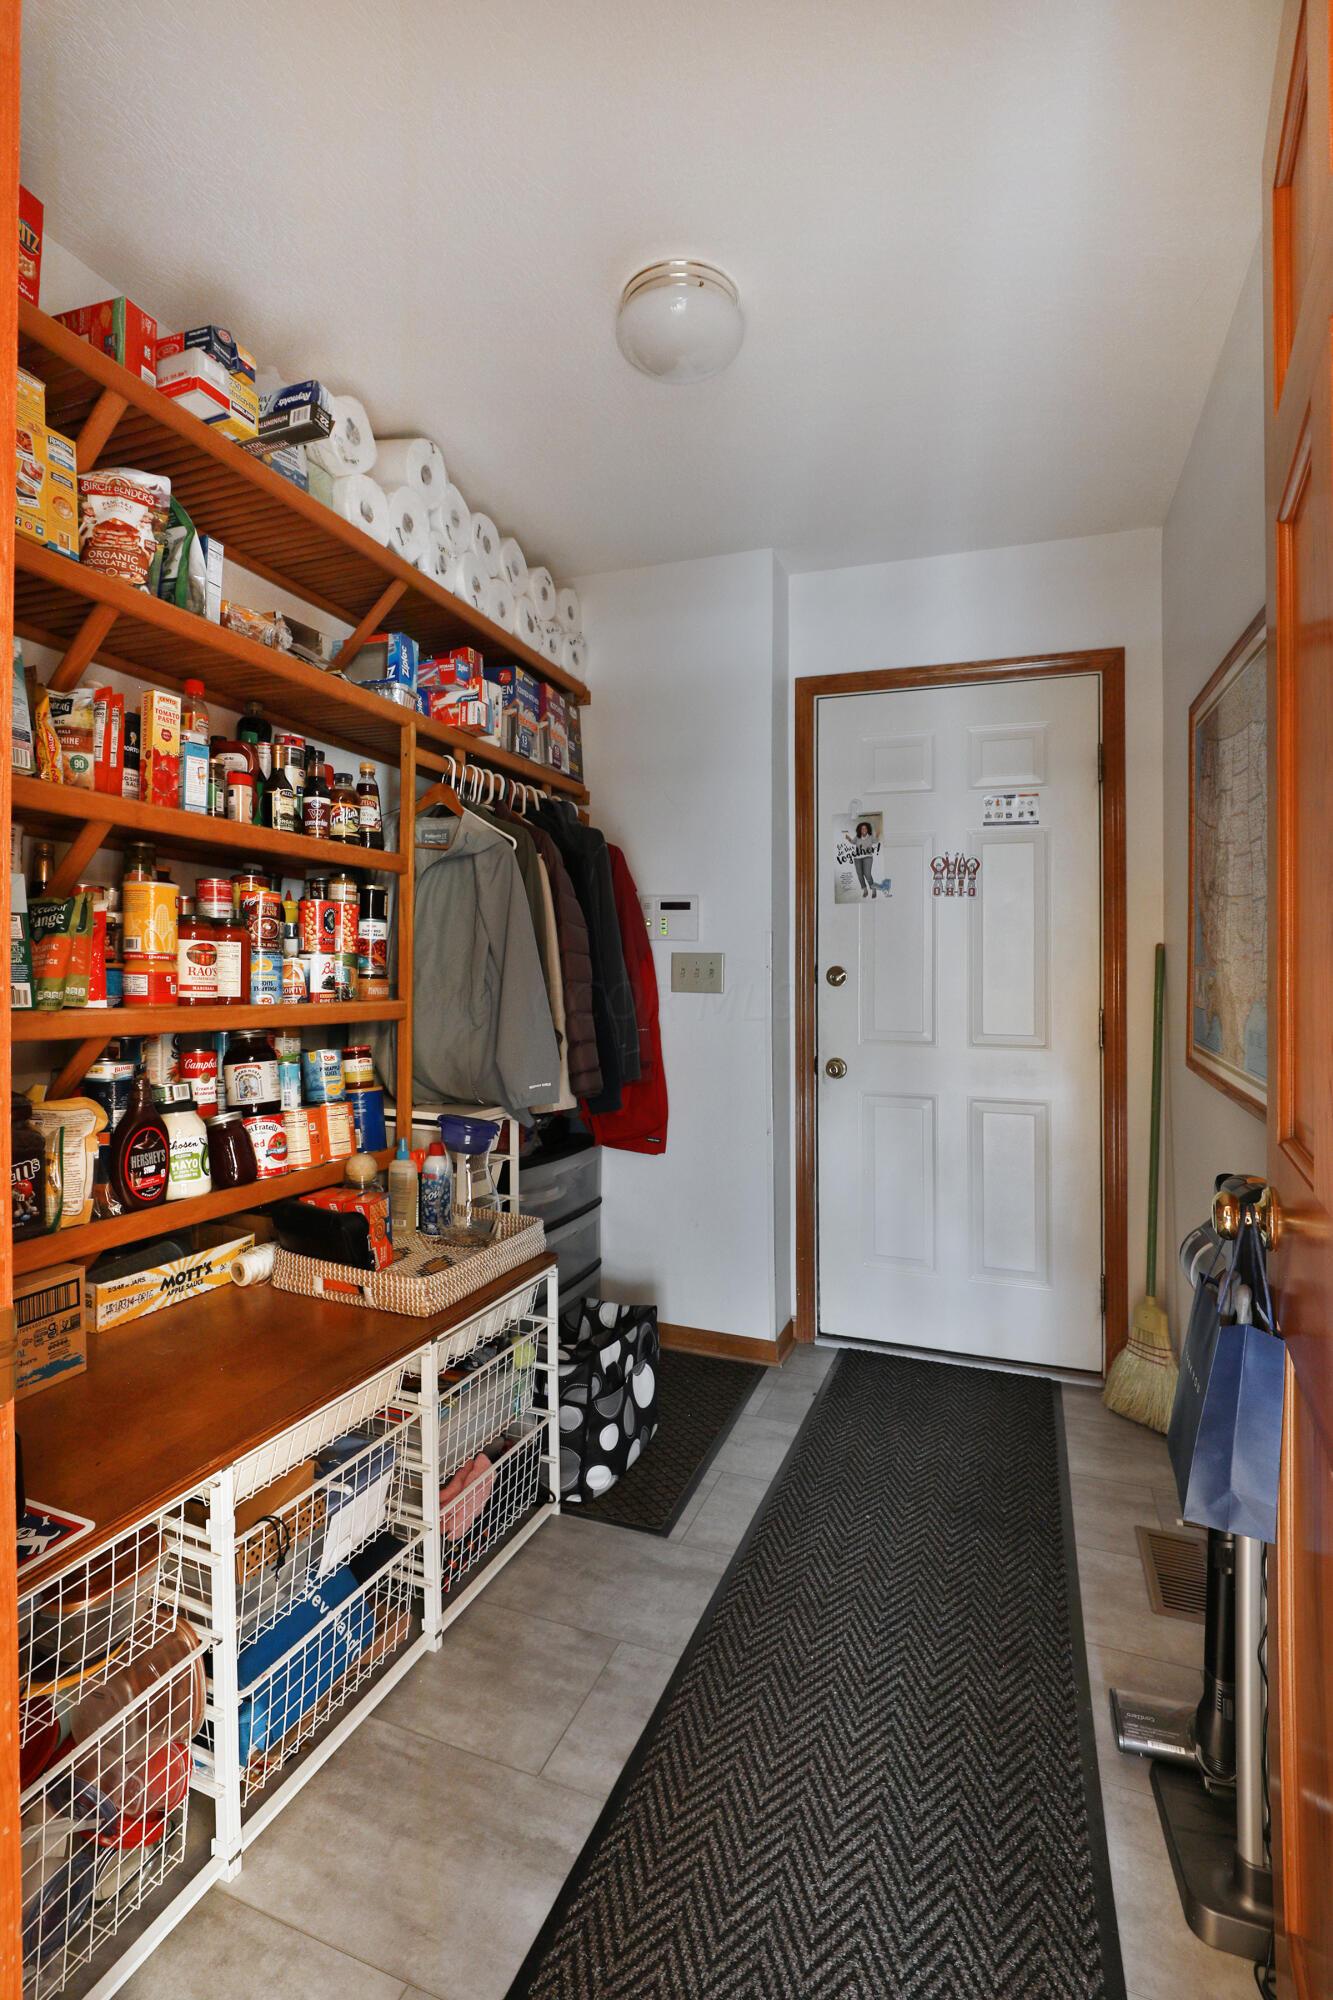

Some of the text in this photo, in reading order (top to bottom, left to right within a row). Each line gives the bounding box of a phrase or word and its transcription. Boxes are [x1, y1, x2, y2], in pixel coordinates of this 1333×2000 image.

[81, 480, 113, 492] BIRCH
[113, 485, 155, 505] BENDERS
[88, 550, 139, 565] ORGANIC
[401, 645, 410, 678] Ziploc
[155, 708, 180, 720] TOMATO
[157, 715, 177, 726] PASTE
[131, 1150, 166, 1169] HERSHEY'S
[171, 1159, 199, 1170] MAYO
[159, 1260, 214, 1292] MOTT'S
[166, 1277, 205, 1297] APPLE SAUCE
